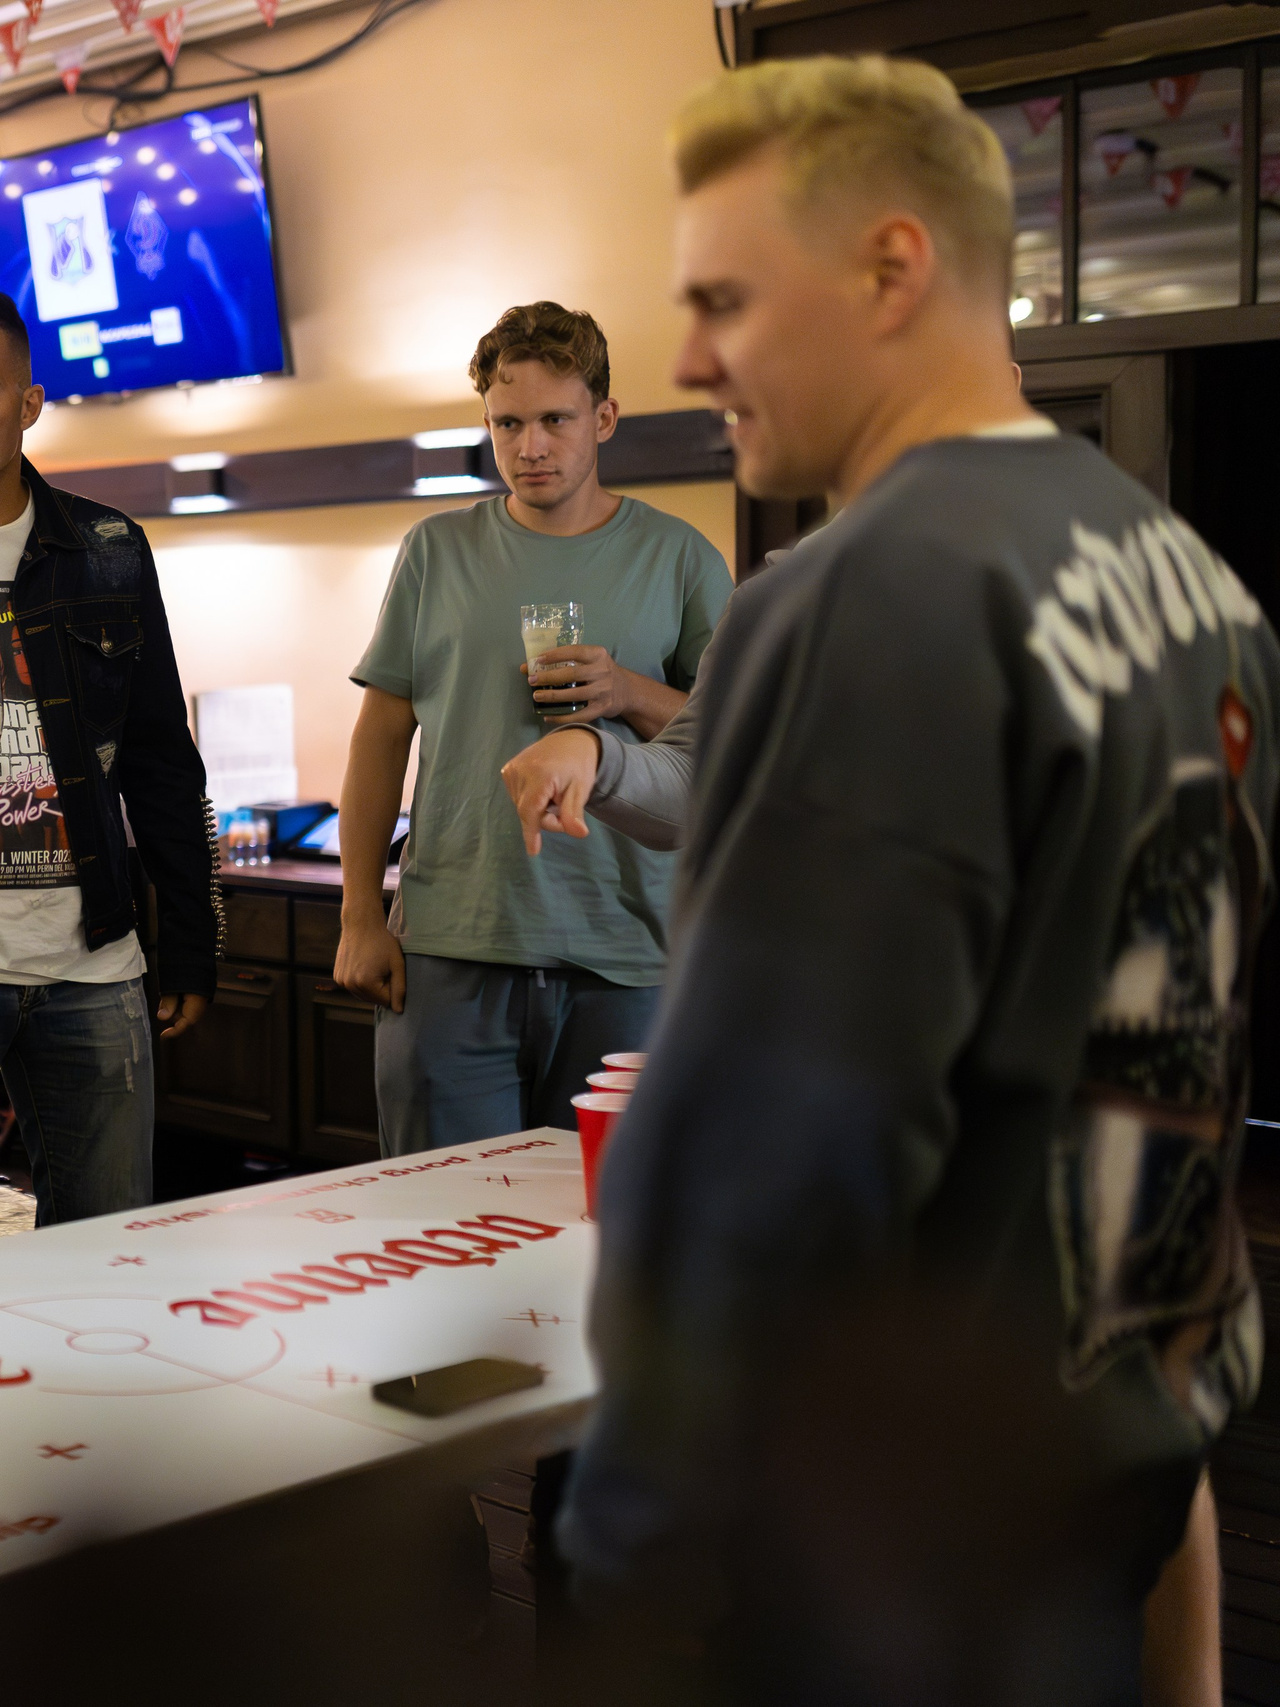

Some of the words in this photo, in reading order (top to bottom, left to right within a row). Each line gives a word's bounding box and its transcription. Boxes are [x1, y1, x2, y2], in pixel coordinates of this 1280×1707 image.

[10, 850, 50, 866] WINTER
[477, 1140, 557, 1159] beer
[379, 1156, 472, 1177] pong
